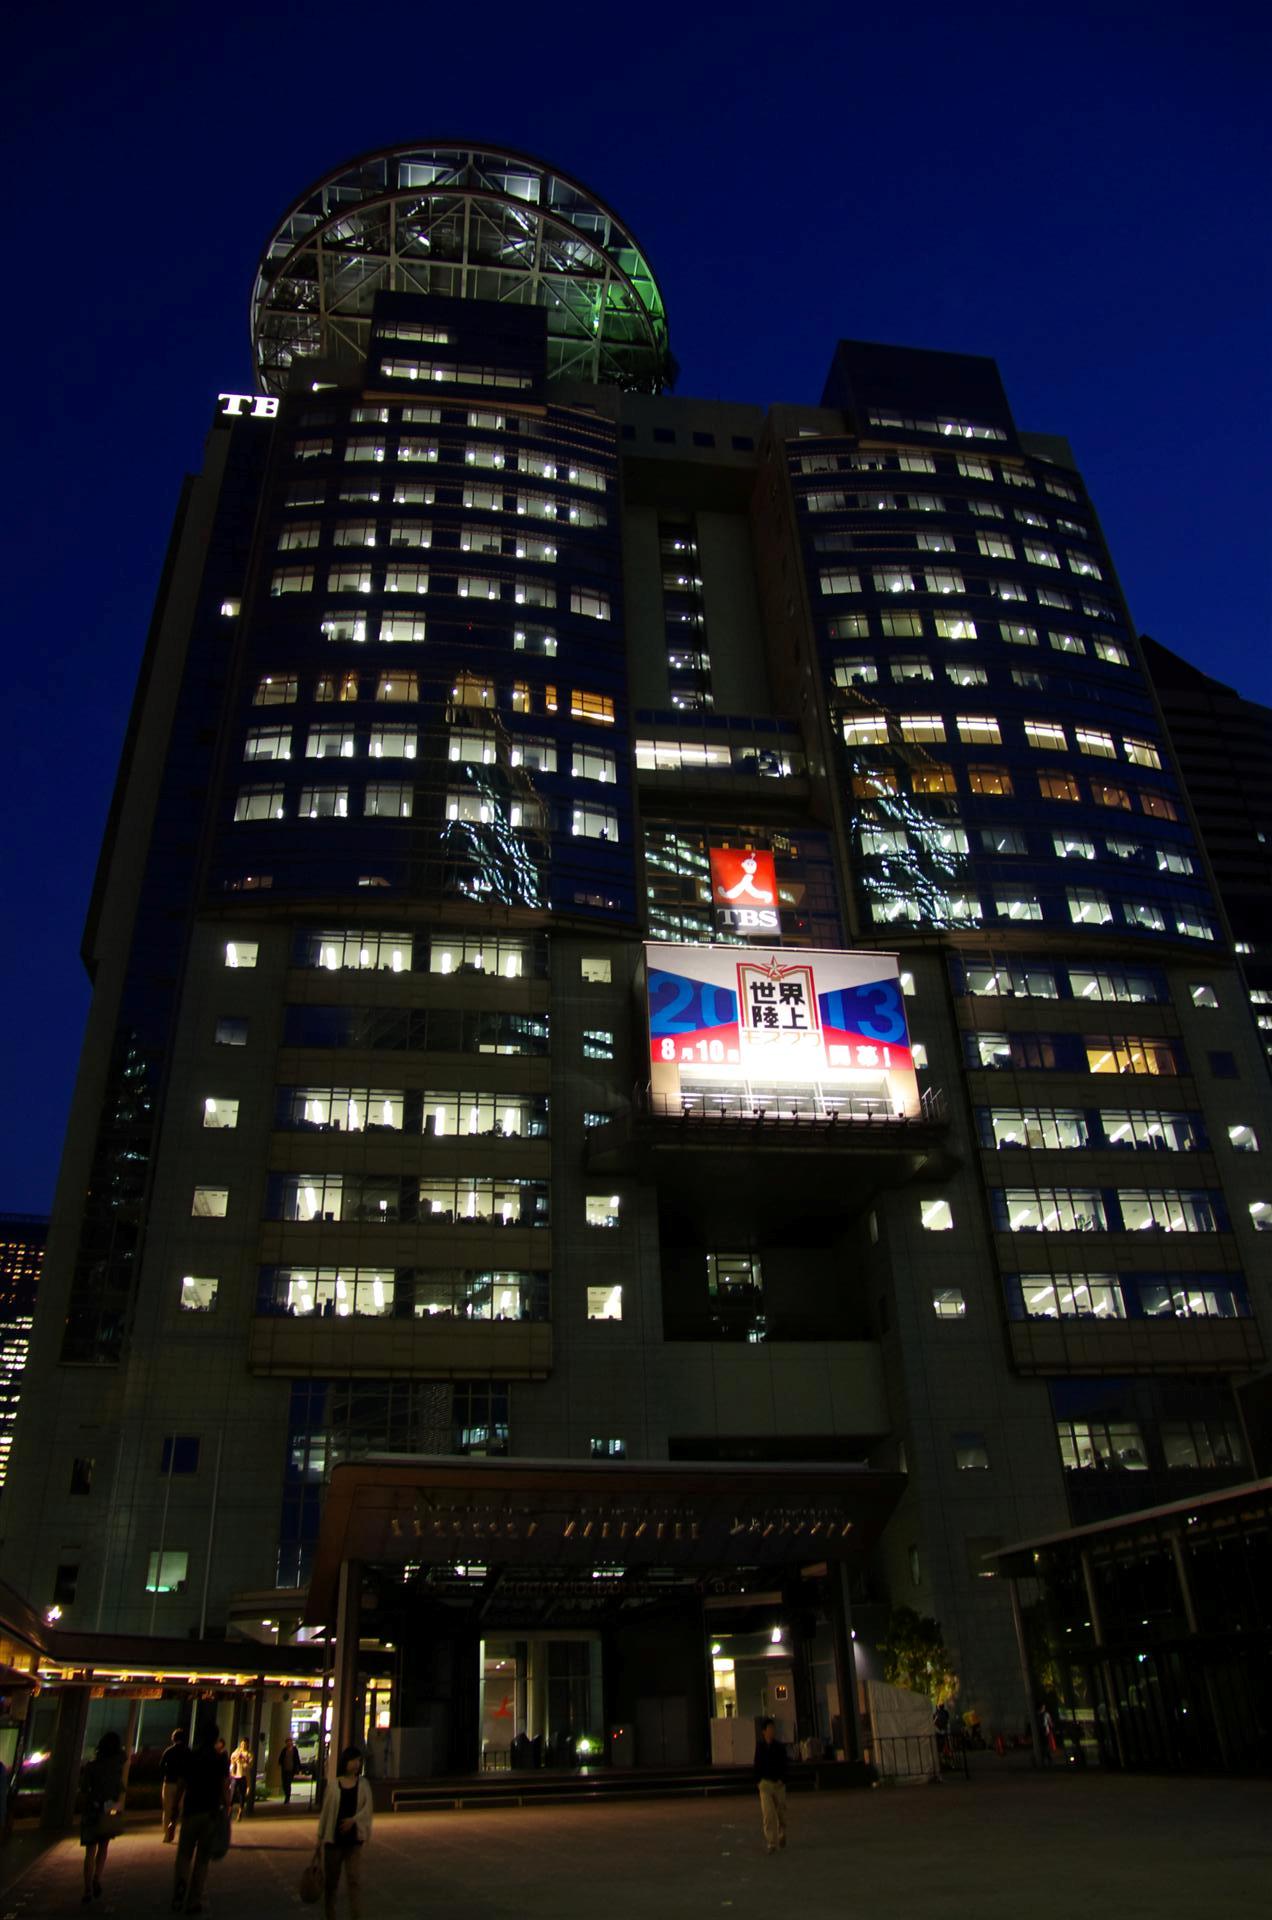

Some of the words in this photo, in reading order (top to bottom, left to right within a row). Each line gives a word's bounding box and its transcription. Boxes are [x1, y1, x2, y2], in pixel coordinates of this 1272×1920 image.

[717, 908, 778, 928] TBS
[750, 981, 806, 1006] 世界
[751, 1005, 808, 1030] 陸上
